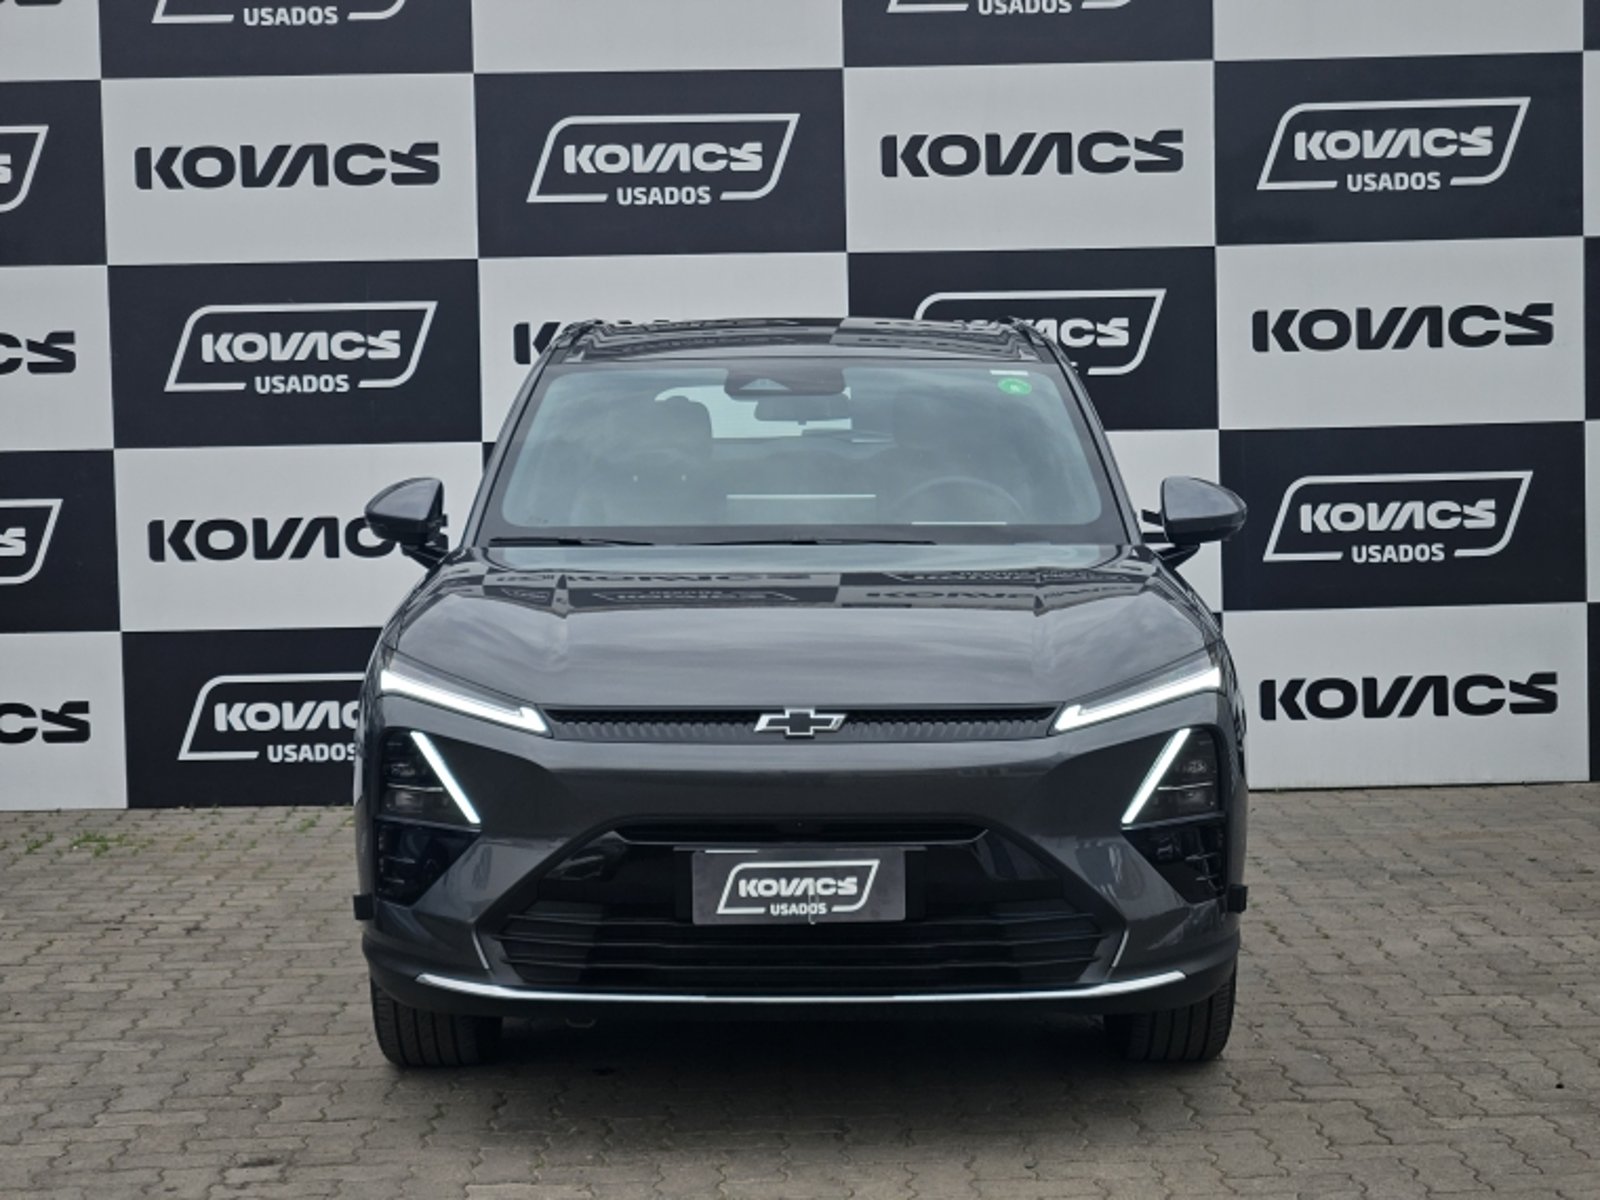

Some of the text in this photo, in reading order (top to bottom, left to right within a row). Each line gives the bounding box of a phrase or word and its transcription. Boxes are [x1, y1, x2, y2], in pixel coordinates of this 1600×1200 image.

[244, 5, 338, 26] USADOS
[563, 142, 763, 174] KOVACS
[881, 129, 1184, 178] KOVACS
[1294, 126, 1493, 161] KOVACS
[134, 141, 440, 190] KOVACS
[1346, 171, 1441, 192] USADOS
[616, 186, 712, 206] USADOS
[1252, 302, 1554, 353] KOVACS
[201, 329, 401, 363] KOVACS
[254, 374, 350, 394] USADOS
[1300, 499, 1496, 533] KOVACS
[148, 517, 397, 563] KOVAC
[1351, 543, 1445, 563] USADOS
[1259, 671, 1558, 721] KOVACS
[738, 876, 859, 898] KOVACS
[770, 902, 828, 916] USADOS
